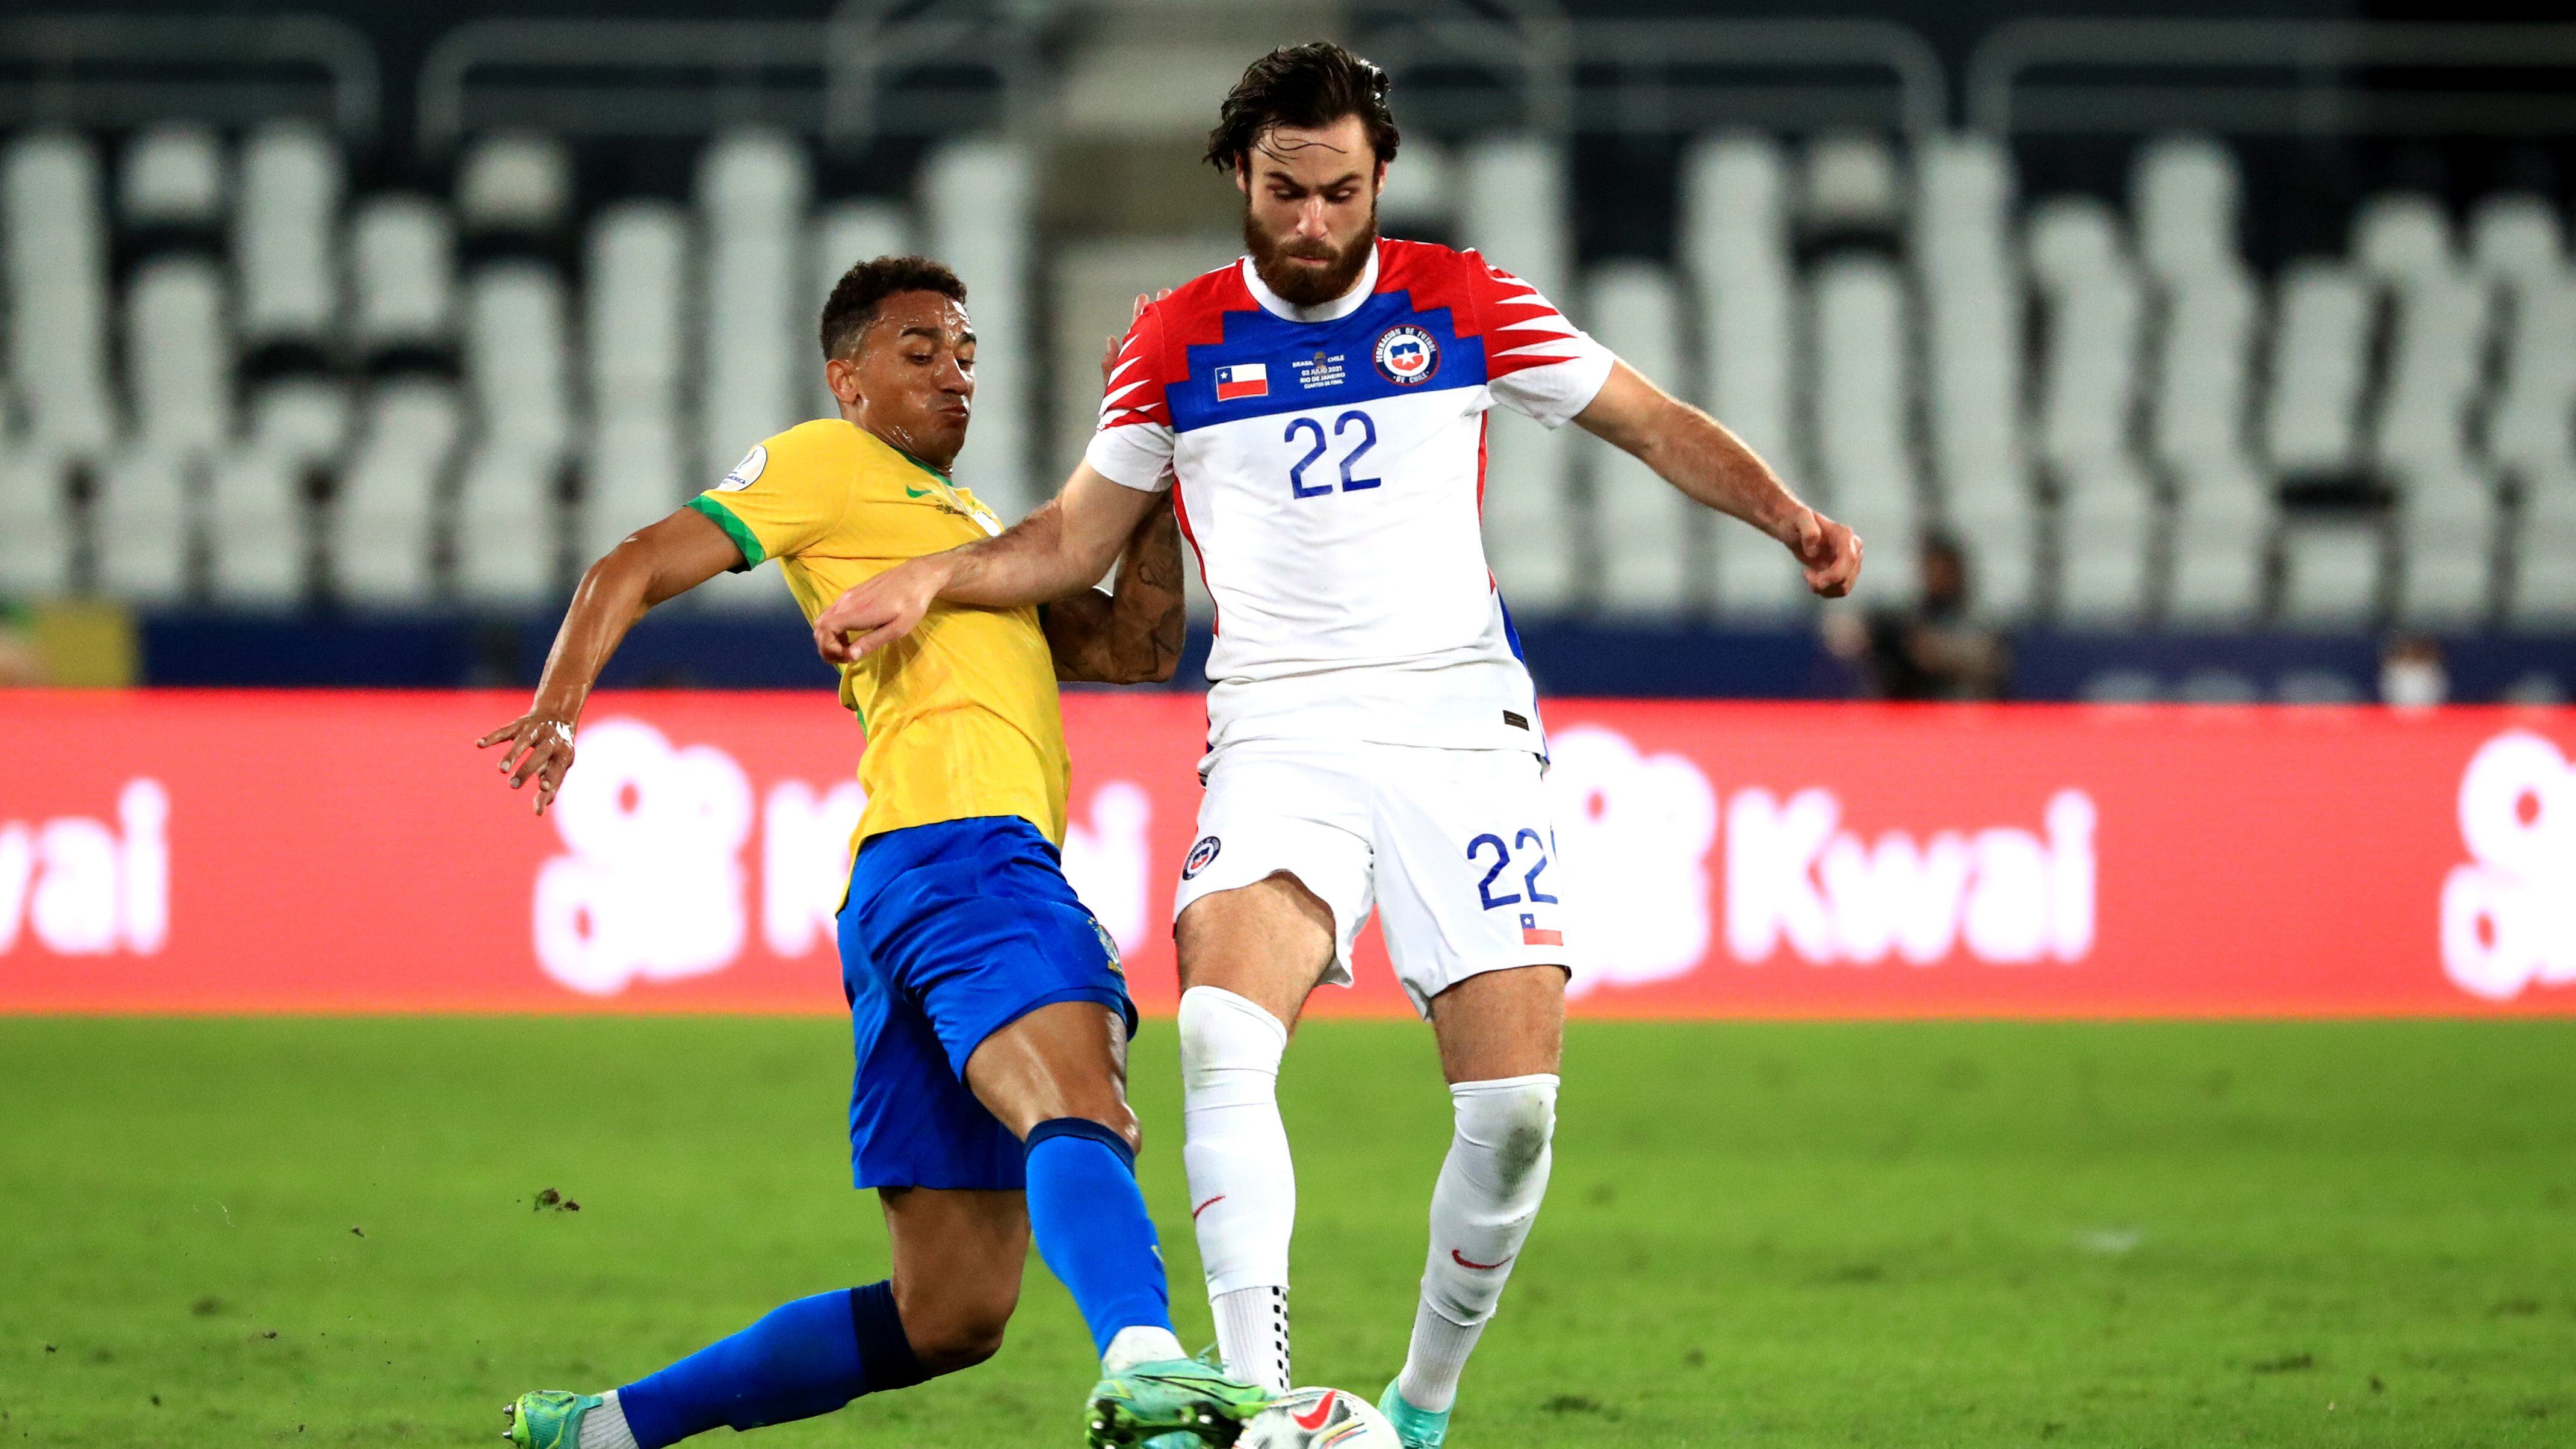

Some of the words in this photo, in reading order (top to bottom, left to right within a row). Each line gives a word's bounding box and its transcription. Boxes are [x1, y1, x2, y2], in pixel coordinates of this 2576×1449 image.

[1321, 372, 1346, 381] JANEIRO
[1409, 371, 1428, 383] CHILE
[1417, 330, 1437, 353] FUTBOL
[1284, 410, 1381, 499] 22
[0, 777, 170, 956] ai
[1467, 828, 1558, 911] 22
[1725, 785, 2097, 964] Kwai
